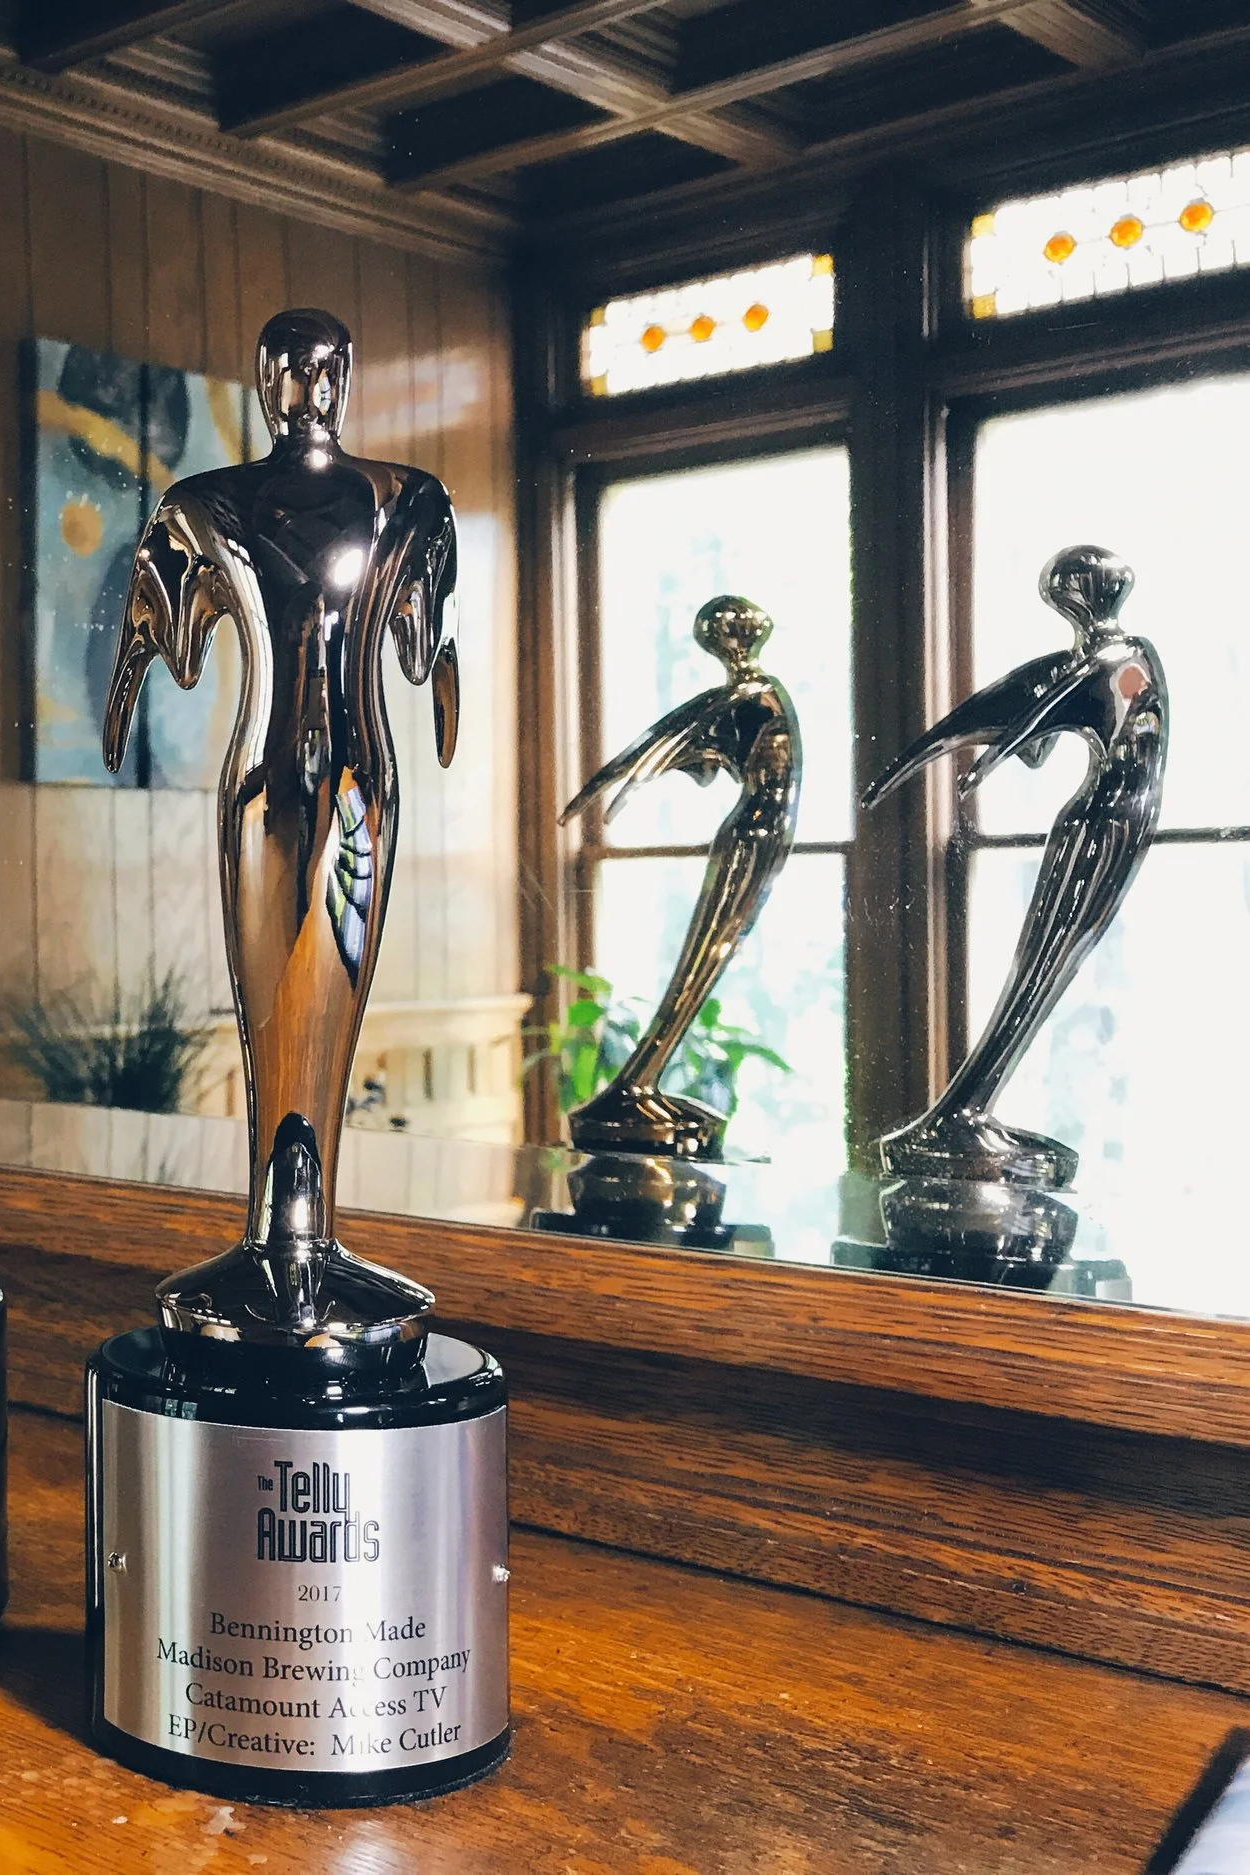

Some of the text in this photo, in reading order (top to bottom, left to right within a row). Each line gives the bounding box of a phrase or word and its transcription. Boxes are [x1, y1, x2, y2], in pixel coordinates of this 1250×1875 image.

[256, 1460, 351, 1520] The Telly
[256, 1507, 381, 1564] Awards
[297, 1584, 343, 1603] 2017
[210, 1611, 427, 1652] Bennington Made
[156, 1637, 472, 1688] Madison Brewing Company
[185, 1681, 321, 1719] Catamount
[413, 1685, 448, 1713] TV
[167, 1712, 316, 1757] EP/Creative:
[398, 1719, 462, 1754] Cutler
